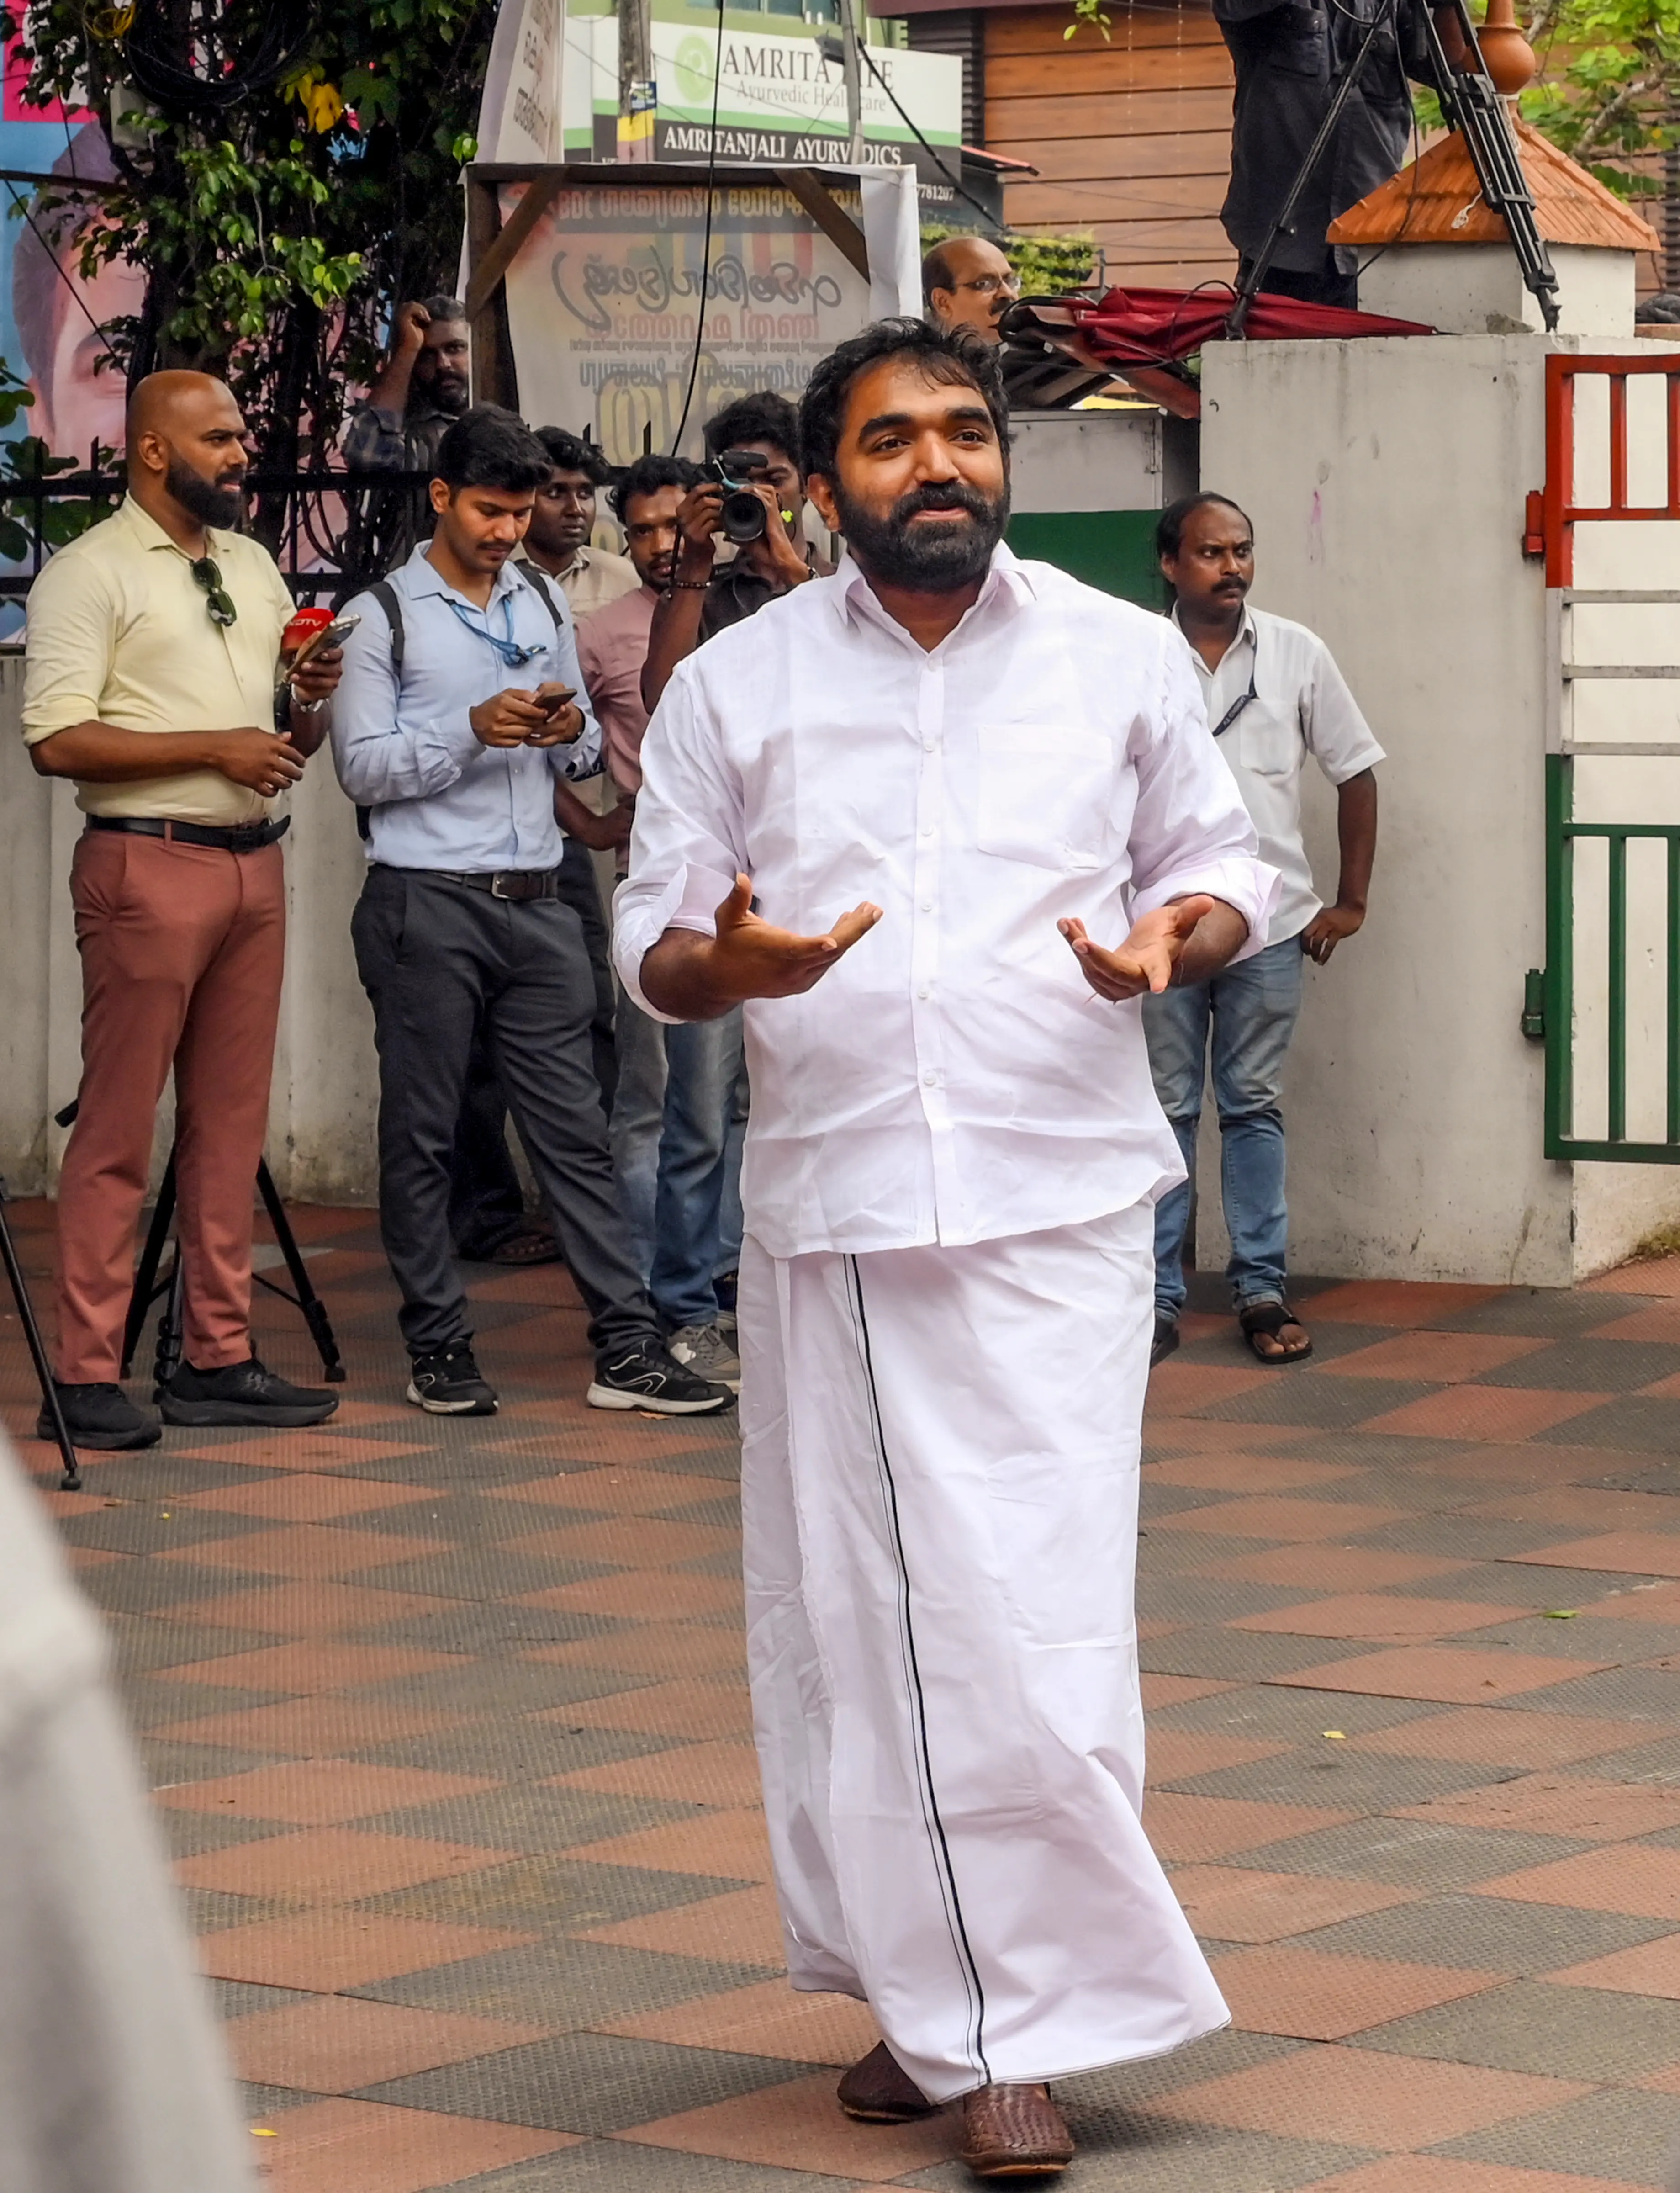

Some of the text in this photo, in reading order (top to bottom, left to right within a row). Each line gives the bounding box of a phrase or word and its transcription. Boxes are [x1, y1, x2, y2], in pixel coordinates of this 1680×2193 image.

[723, 44, 893, 90] AMRITA IFE
[737, 80, 809, 106] Ayurvedic
[664, 125, 902, 166] AMRITANJALI AYURVDICS
